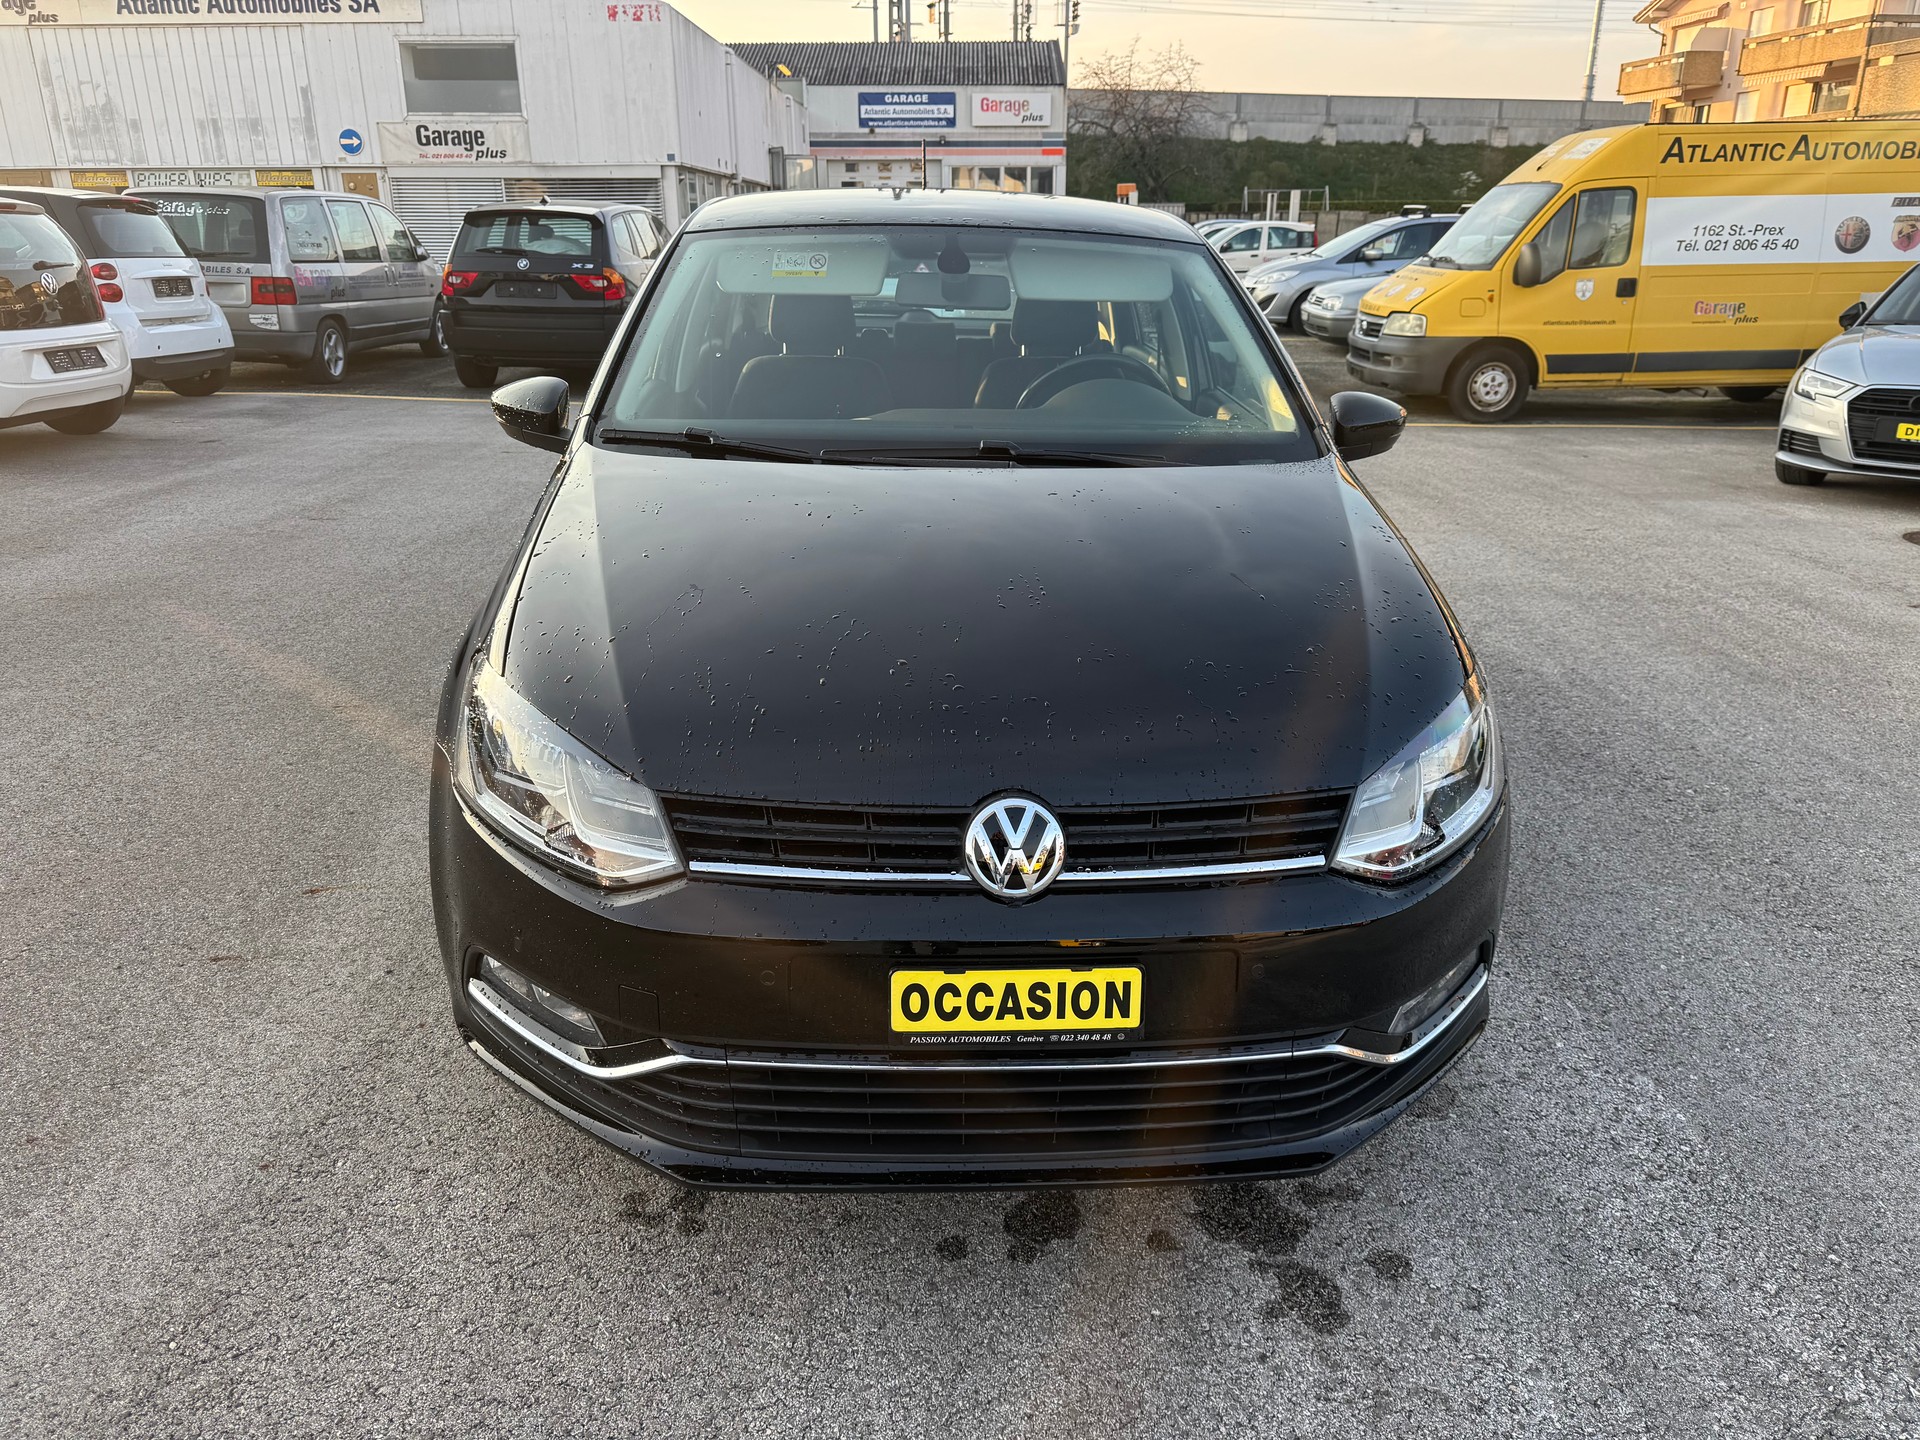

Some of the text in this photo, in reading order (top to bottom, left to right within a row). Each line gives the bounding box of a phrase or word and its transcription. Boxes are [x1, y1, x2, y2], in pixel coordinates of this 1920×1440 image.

[116, 0, 380, 15] Atlantic Automobiles SA
[28, 11, 59, 25] plus
[884, 94, 929, 103] GARAGE
[864, 107, 951, 116] Atlantic Automobiles S.A.
[980, 97, 1030, 117] Garage
[1021, 113, 1044, 123] plus
[415, 124, 485, 152] Garage
[475, 147, 507, 161] plus
[1660, 136, 1786, 164] ATLANTIC
[1693, 224, 1785, 237] 1162 St.-Prex
[1676, 238, 1799, 252] Tél. 021 806 45 40
[236, 266, 254, 275] S.A.
[331, 287, 346, 300] plus
[1693, 300, 1746, 318] Garage
[1734, 314, 1760, 325] plus
[900, 980, 1132, 1022] OCCASION
[909, 1033, 1112, 1044] PASSION AUTOMOBILES Genève 022 340 48 48
